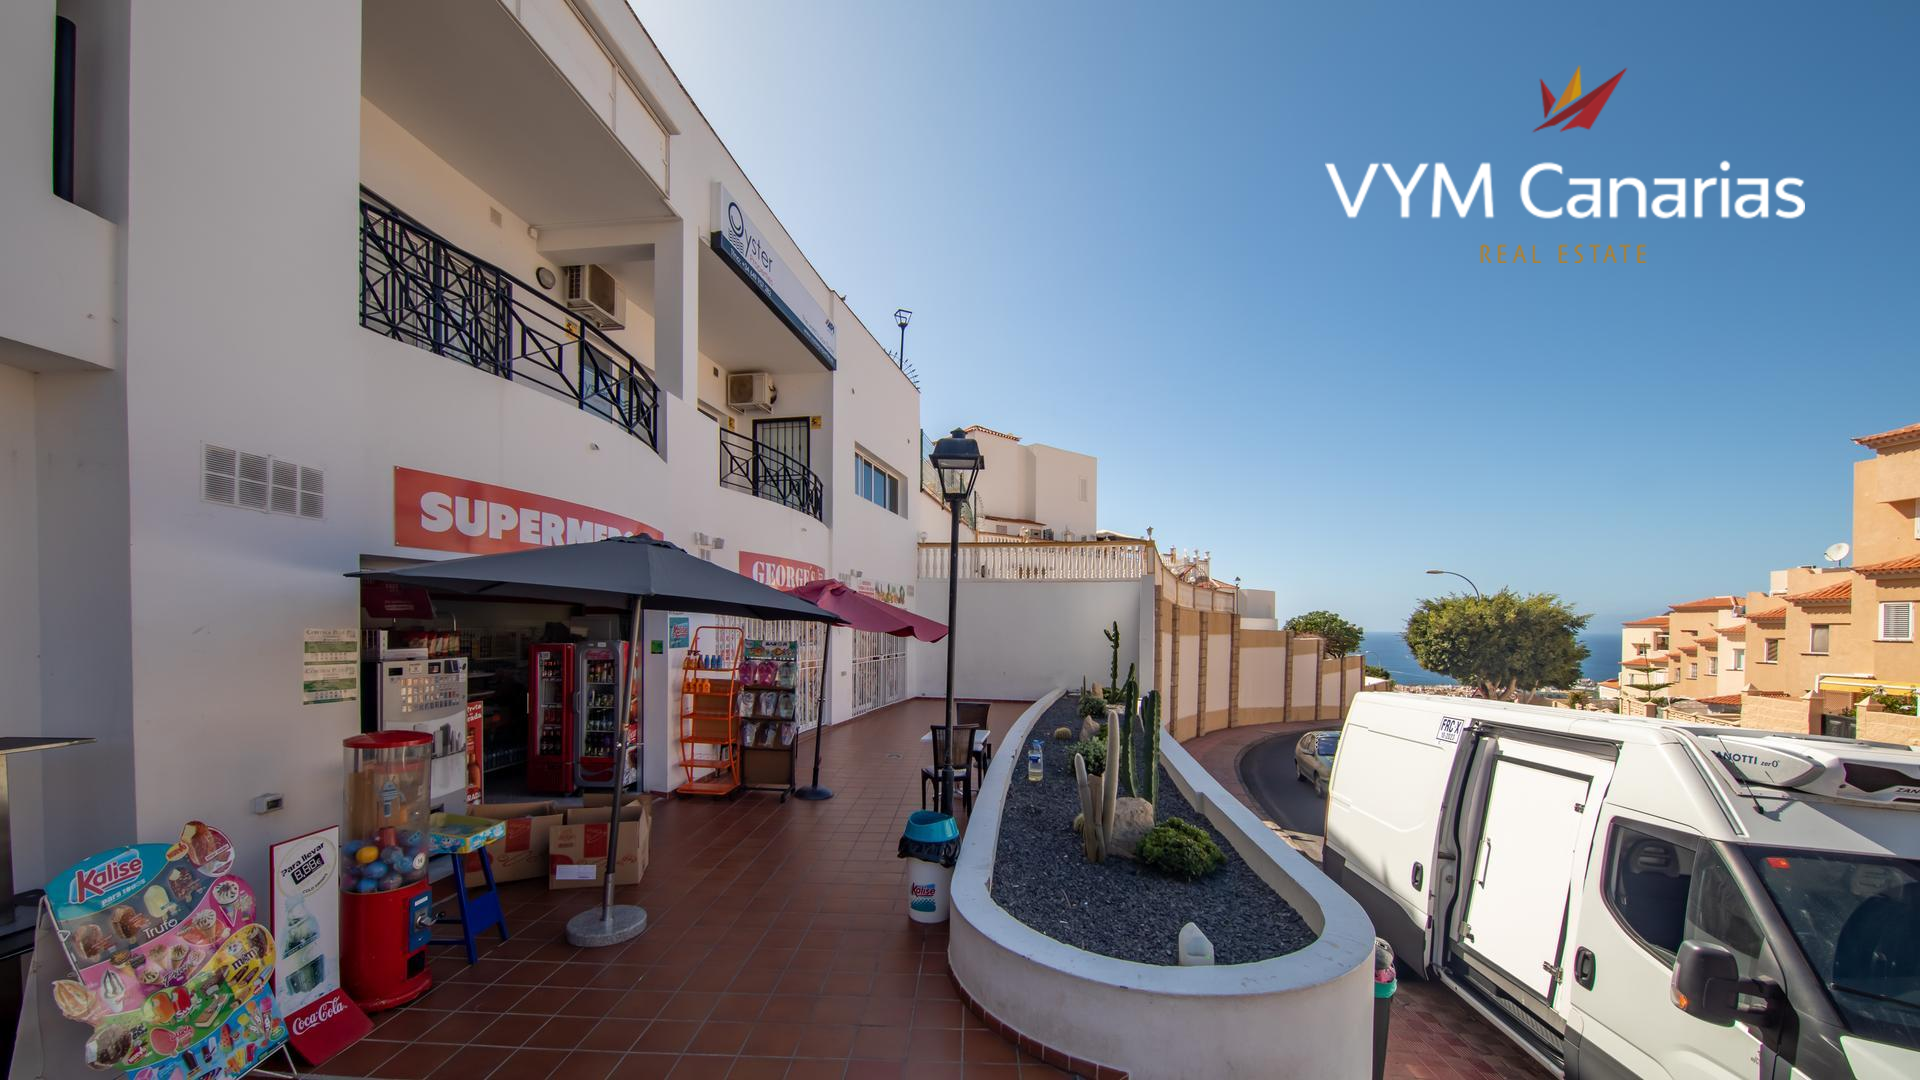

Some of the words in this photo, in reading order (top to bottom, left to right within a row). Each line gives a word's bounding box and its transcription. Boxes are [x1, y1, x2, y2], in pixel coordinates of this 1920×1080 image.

[728, 202, 773, 272] Oyster
[420, 491, 634, 547] SUPERME
[76, 858, 142, 902] Kalise
[281, 861, 301, 877] Para
[301, 842, 324, 861] llevar
[911, 882, 936, 897] Kalise
[293, 996, 344, 1035] Coca-Cola
